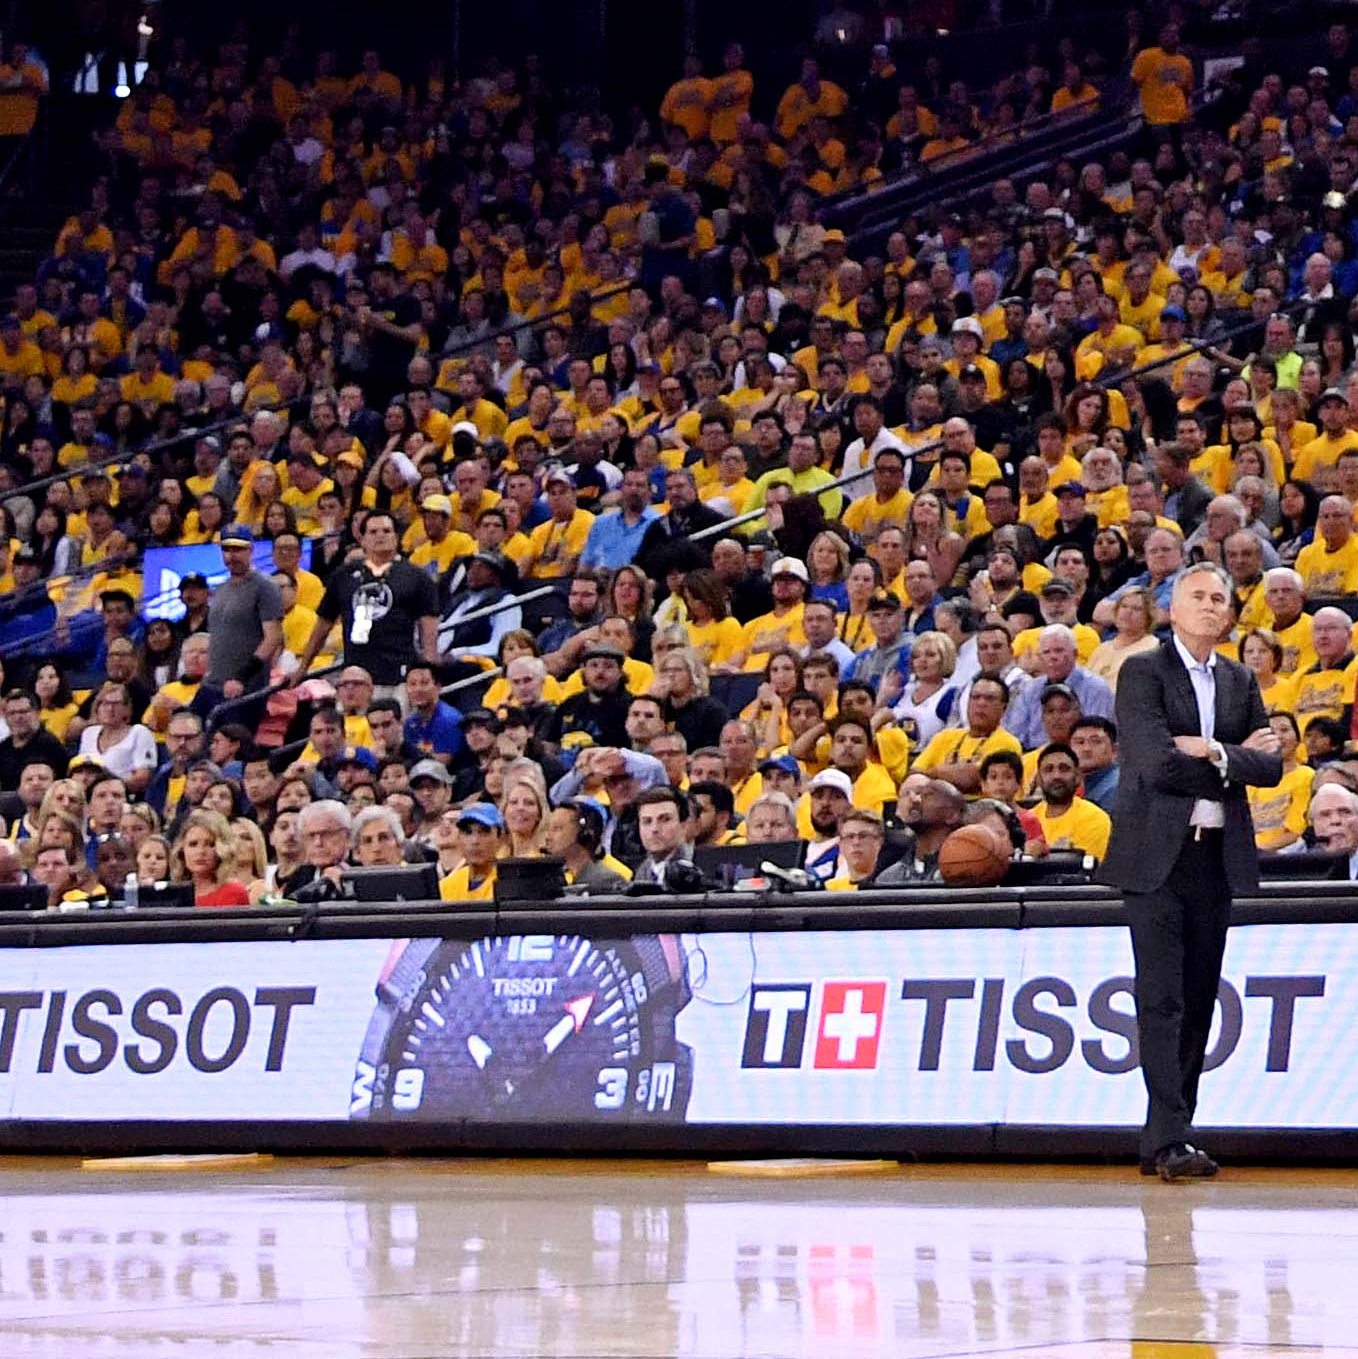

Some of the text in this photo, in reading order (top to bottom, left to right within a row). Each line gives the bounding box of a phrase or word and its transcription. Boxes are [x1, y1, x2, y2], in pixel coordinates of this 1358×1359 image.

[491, 977, 558, 996] TISSOT
[0, 986, 317, 1074] TISSOT
[392, 1069, 425, 1110] 9
[595, 1068, 628, 1109] 3
